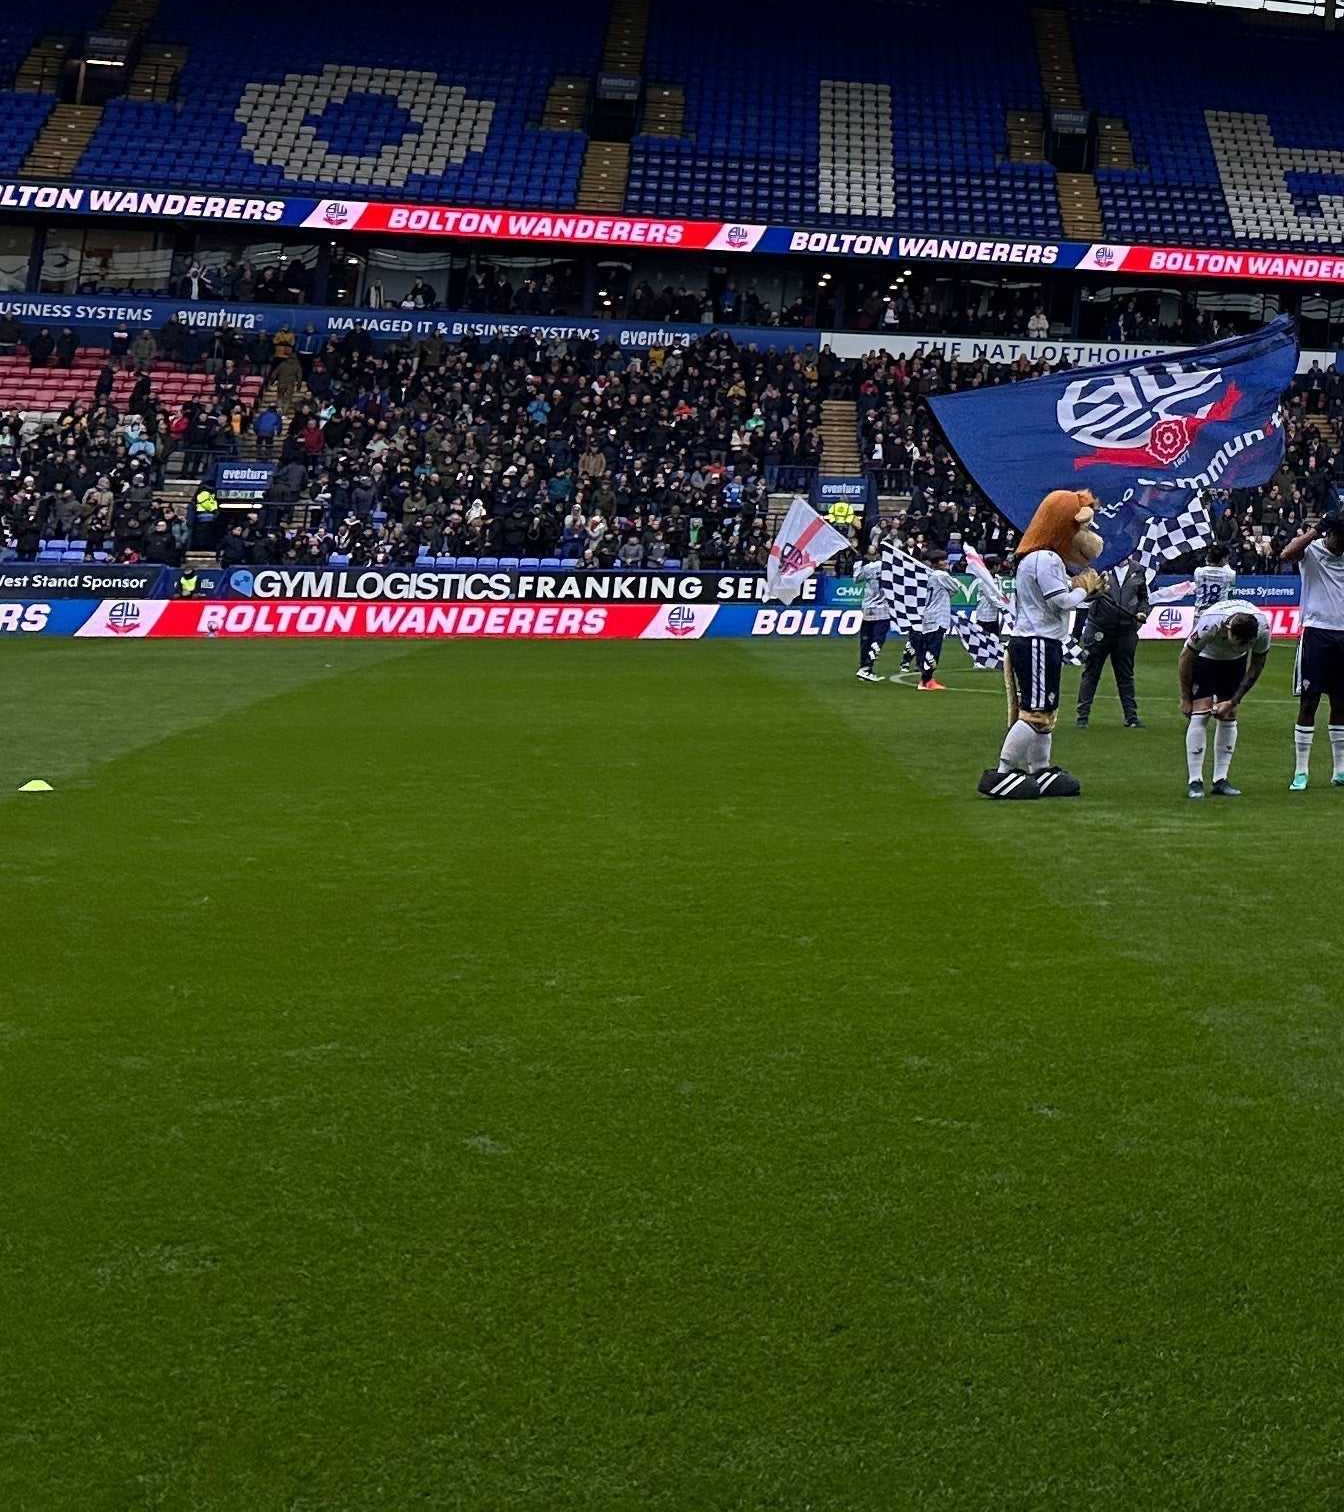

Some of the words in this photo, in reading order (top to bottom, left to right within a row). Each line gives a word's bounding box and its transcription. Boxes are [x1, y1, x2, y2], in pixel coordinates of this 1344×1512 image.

[0, 184, 84, 210] LTON
[90, 190, 285, 221] WANDERERS
[388, 207, 502, 234] BOLTON
[507, 215, 684, 244] WANDERERS
[789, 231, 893, 256] BOLTON
[897, 238, 1060, 264] WANDERERS
[1150, 251, 1244, 274] BOLTON
[75, 306, 153, 322] SYSTEMS
[178, 308, 256, 329] eventura
[417, 321, 430, 335] IT
[437, 322, 448, 335] &
[917, 340, 943, 358] THE
[973, 343, 1024, 361] NAT
[222, 467, 268, 480] eventura
[31, 574, 78, 588] Stand
[81, 575, 147, 590] Sponsor
[254, 571, 334, 598] GYM
[517, 576, 702, 599] FRANKING
[716, 576, 817, 600] SENE
[1257, 586, 1294, 597] Systems
[197, 604, 356, 634] BOLTON
[365, 606, 607, 635] WANDERERS
[751, 609, 864, 635] BOLTO
